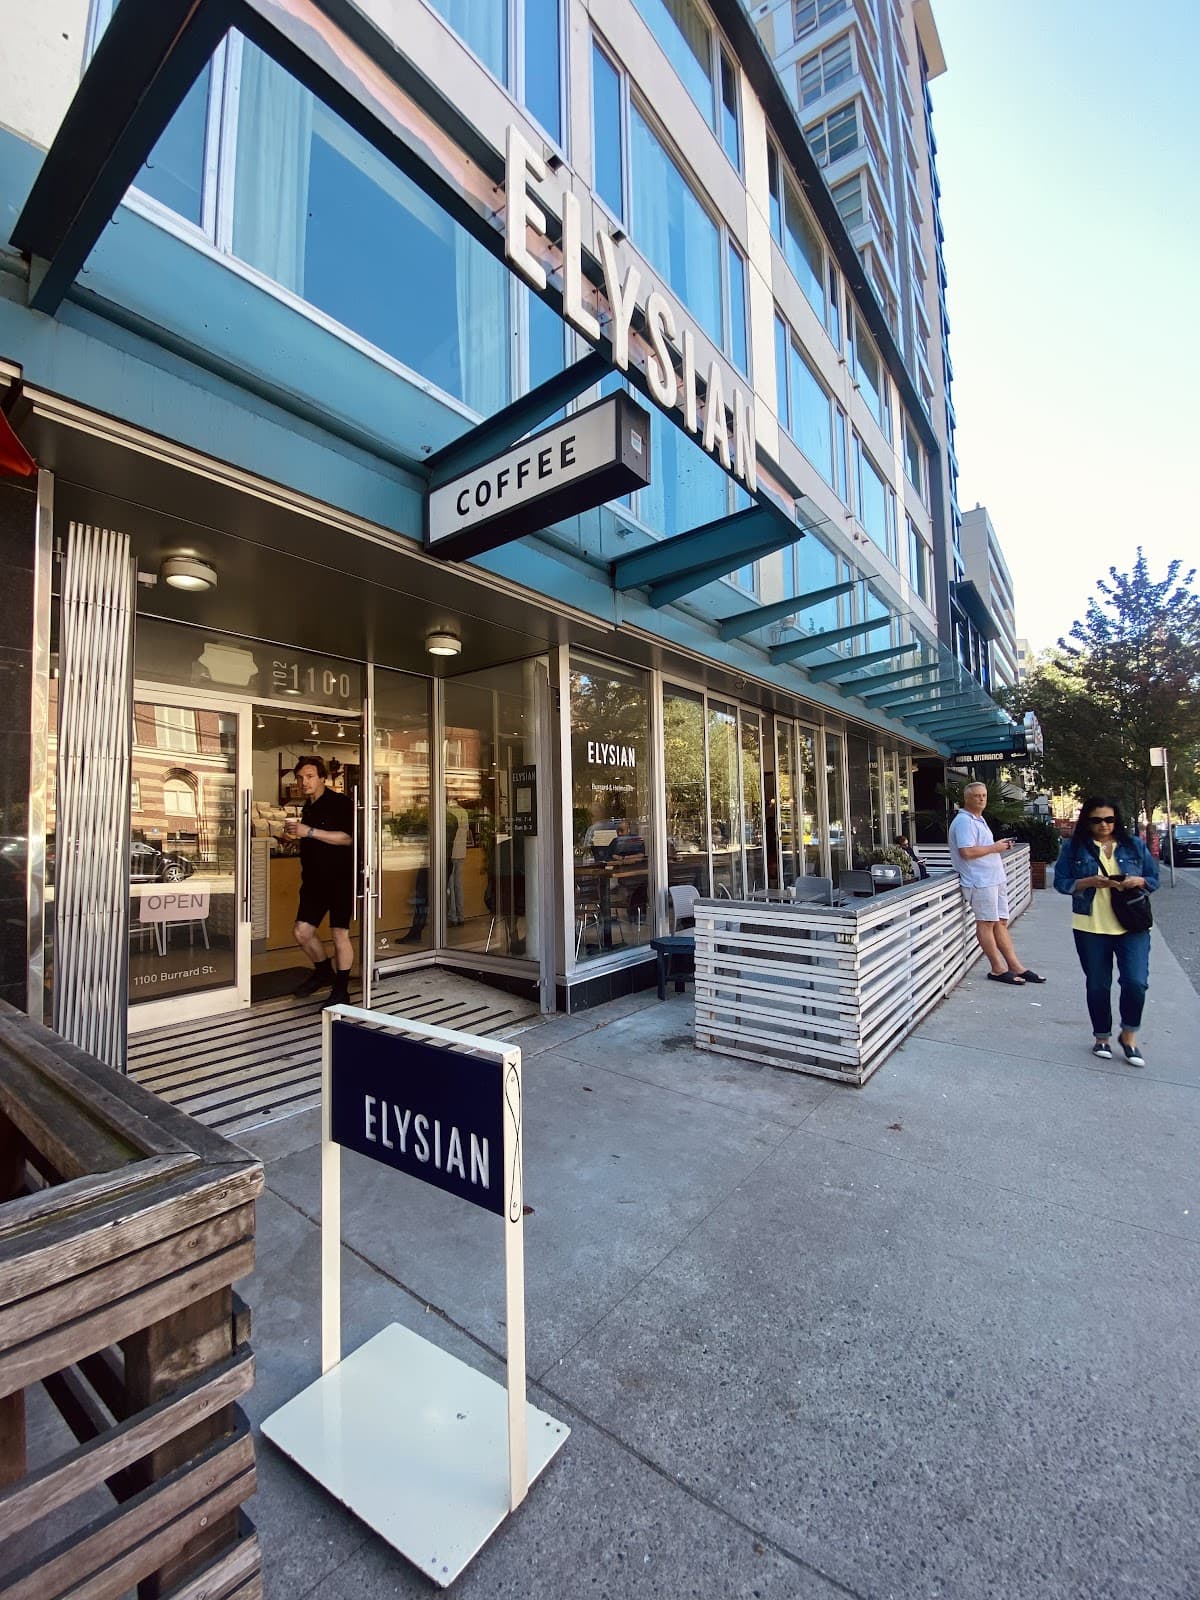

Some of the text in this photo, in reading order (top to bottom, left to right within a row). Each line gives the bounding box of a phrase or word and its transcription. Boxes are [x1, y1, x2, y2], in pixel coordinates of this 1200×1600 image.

[505, 123, 757, 493] ELYSIAN
[457, 435, 577, 516] COFFEE
[291, 663, 350, 698] 1100
[588, 741, 636, 768] ELYSIAN
[147, 893, 204, 910] OPEN
[133, 965, 217, 985] 1100 Burrard St.
[365, 1094, 490, 1190] ELYSIAN
